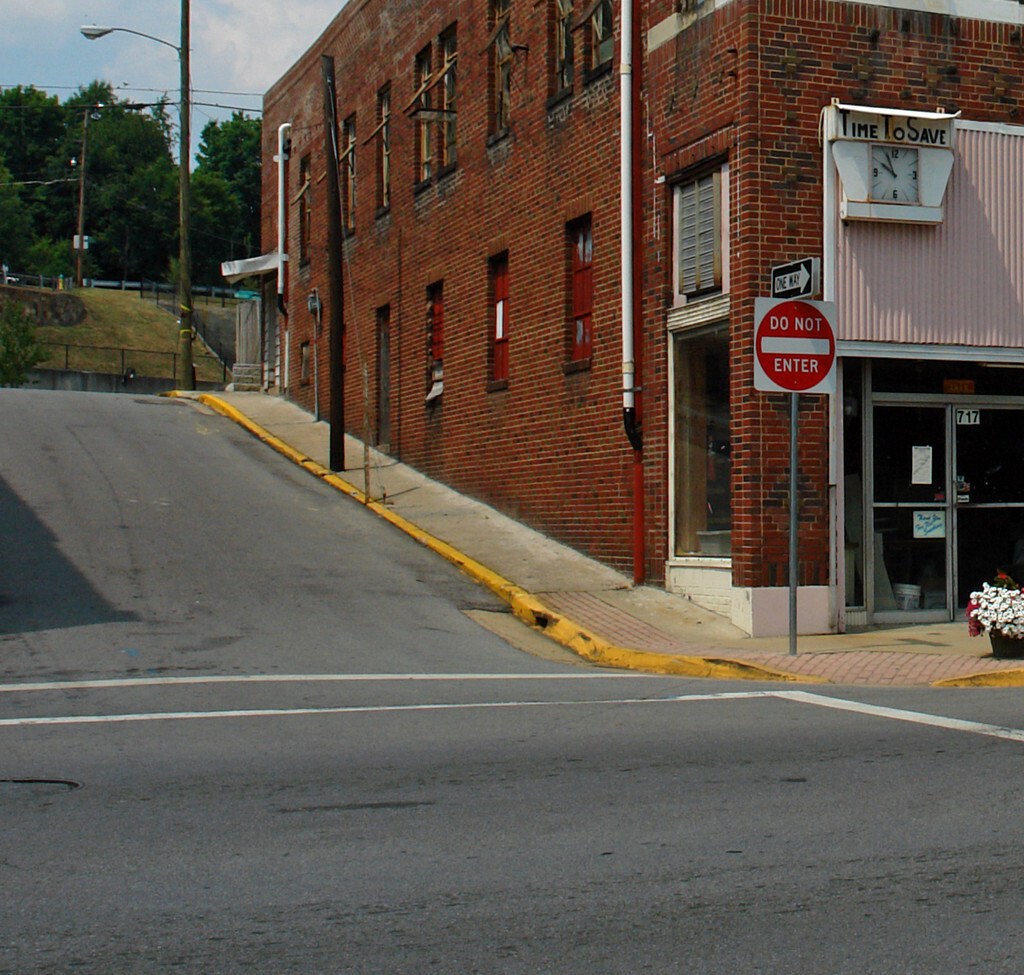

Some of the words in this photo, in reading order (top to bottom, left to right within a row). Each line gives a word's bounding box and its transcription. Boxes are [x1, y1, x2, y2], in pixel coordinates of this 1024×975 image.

[891, 149, 899, 159] 12
[873, 168, 878, 177] 9
[912, 171, 917, 180] 3
[893, 190, 898, 199] 6
[776, 275, 787, 291] ONE
[789, 272, 801, 287] WAY
[770, 316, 789, 331] DO
[794, 317, 822, 332] NOT
[774, 358, 819, 373] ENTER
[957, 410, 979, 423] 717
